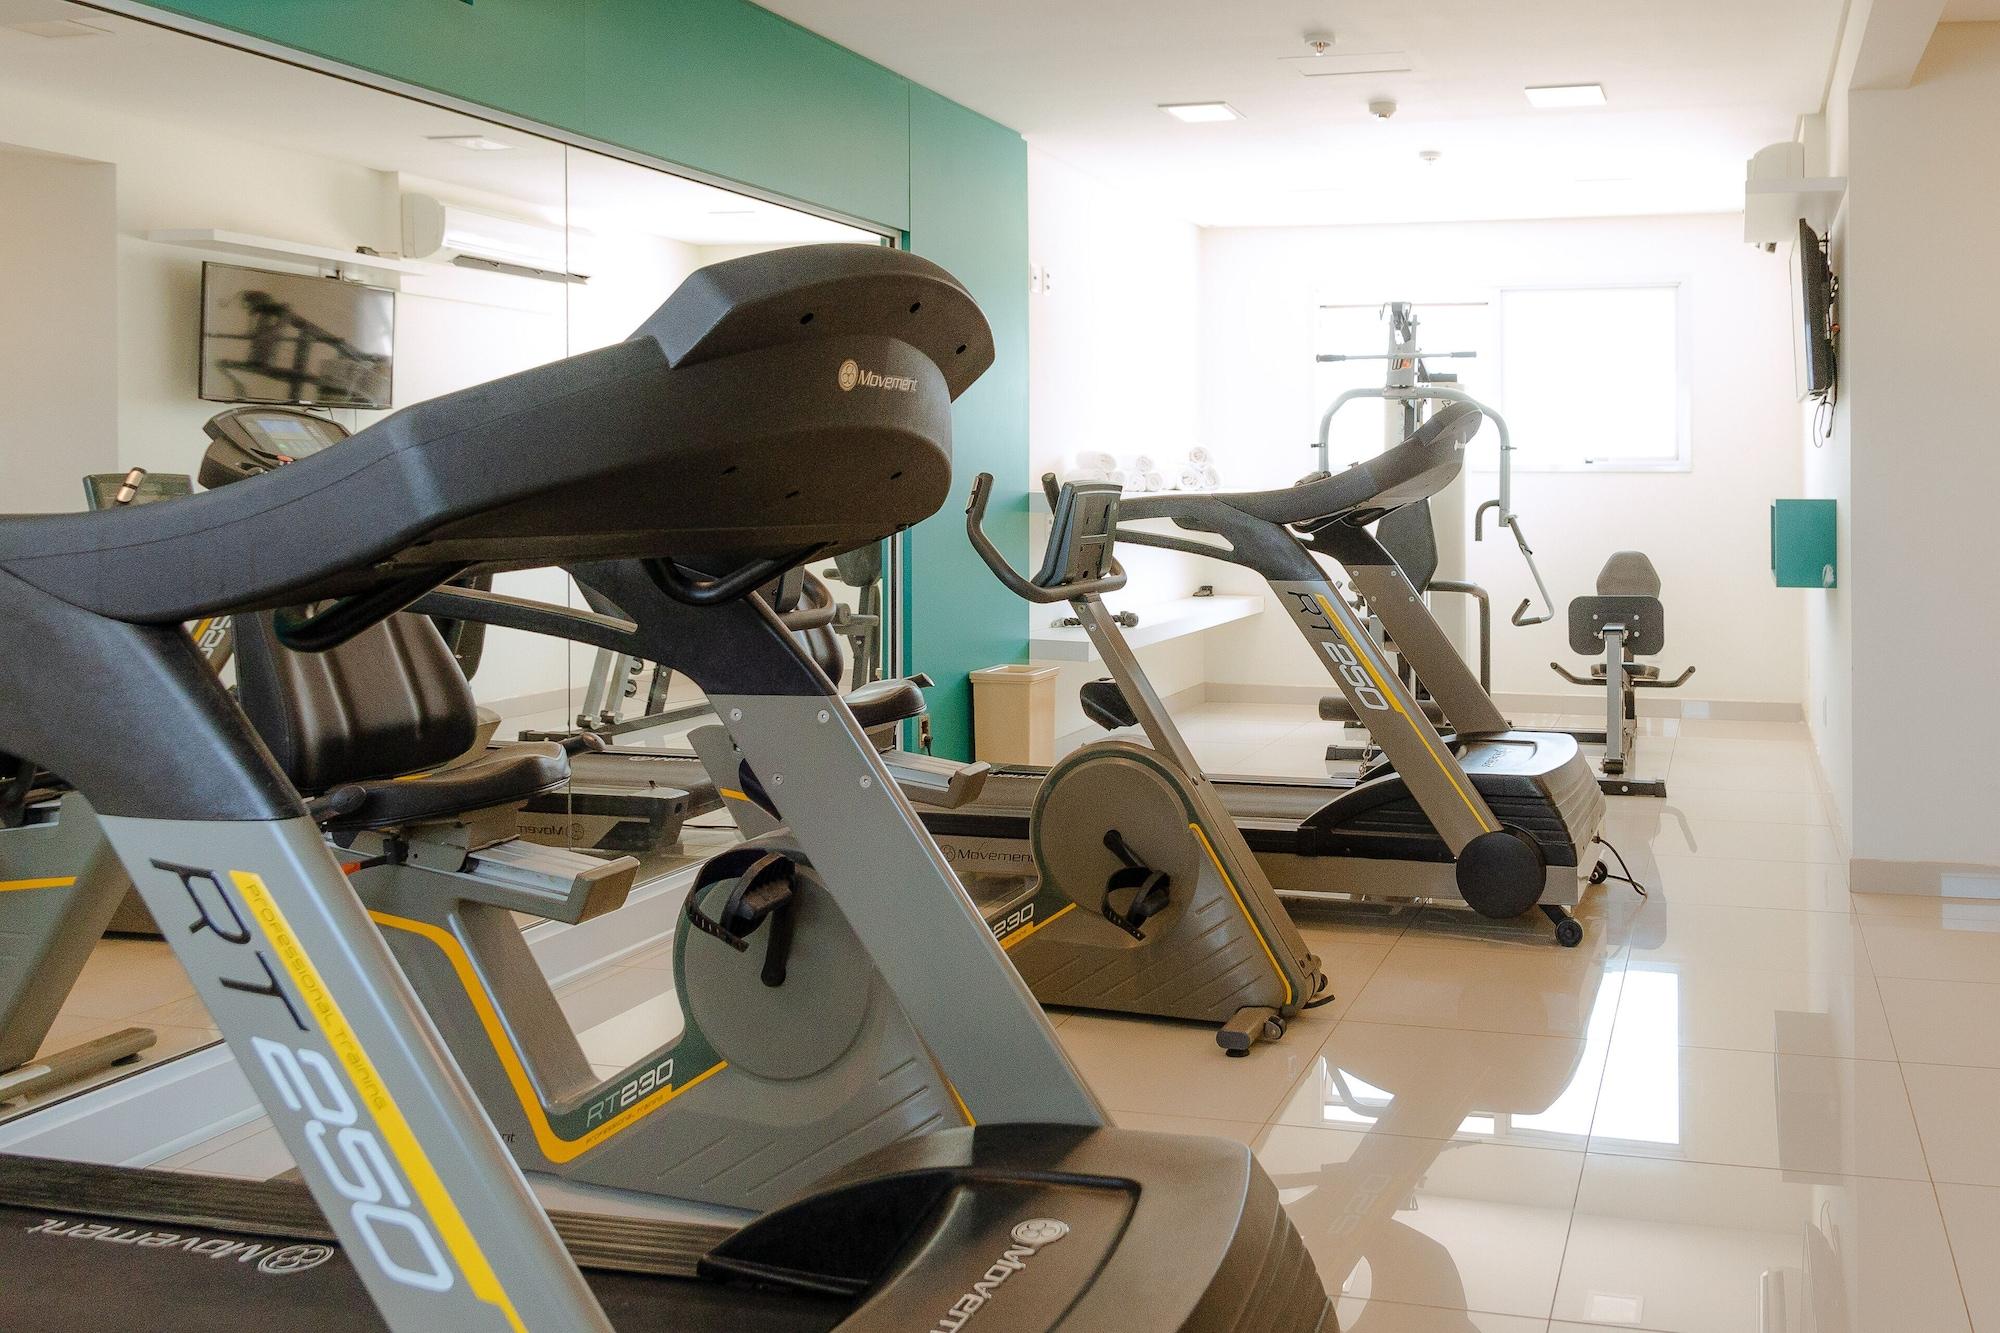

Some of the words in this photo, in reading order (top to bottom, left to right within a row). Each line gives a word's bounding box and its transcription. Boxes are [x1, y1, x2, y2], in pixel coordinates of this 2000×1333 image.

[858, 369, 919, 392] Movement
[958, 848, 1034, 863] Movemen
[28, 1218, 273, 1263] Movement
[929, 1244, 1036, 1333] Movem
